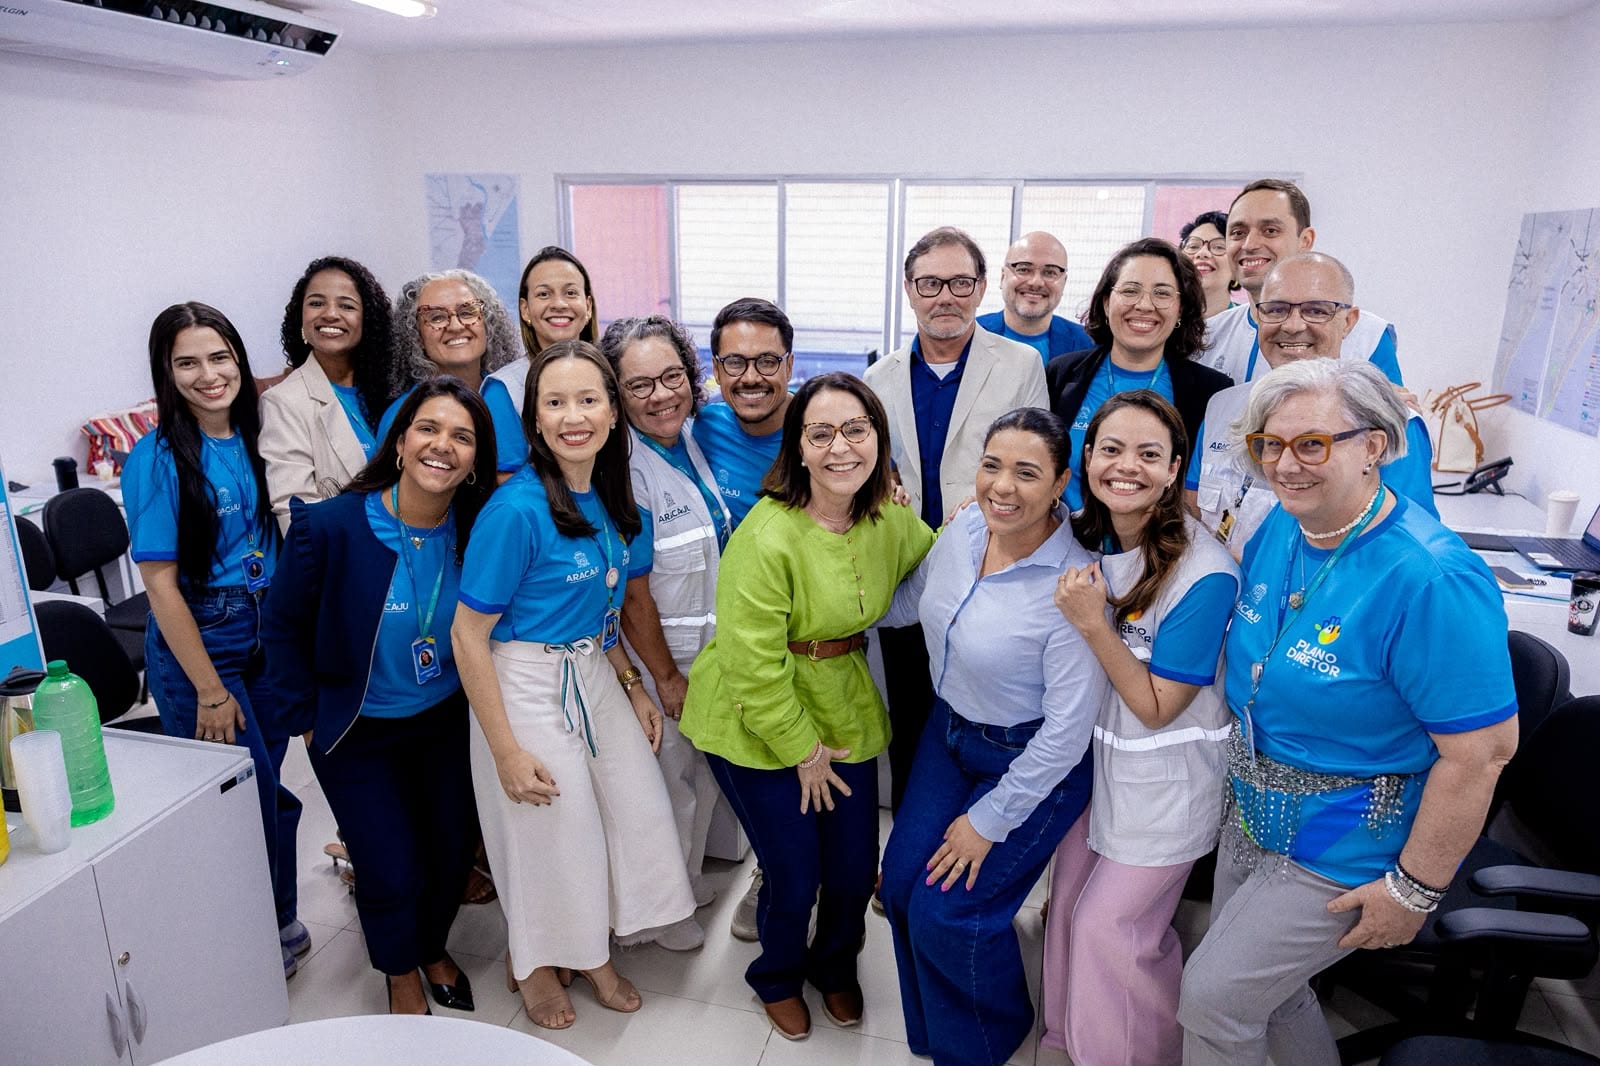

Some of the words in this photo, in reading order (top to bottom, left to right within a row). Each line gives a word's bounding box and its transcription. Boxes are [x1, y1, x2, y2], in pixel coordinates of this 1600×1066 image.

[718, 486, 740, 497] CAJU
[384, 602, 409, 611] CAJU
[1236, 600, 1262, 623] ACAJU
[1286, 647, 1340, 677] DIRETOR
[1296, 639, 1337, 664] PLANO
